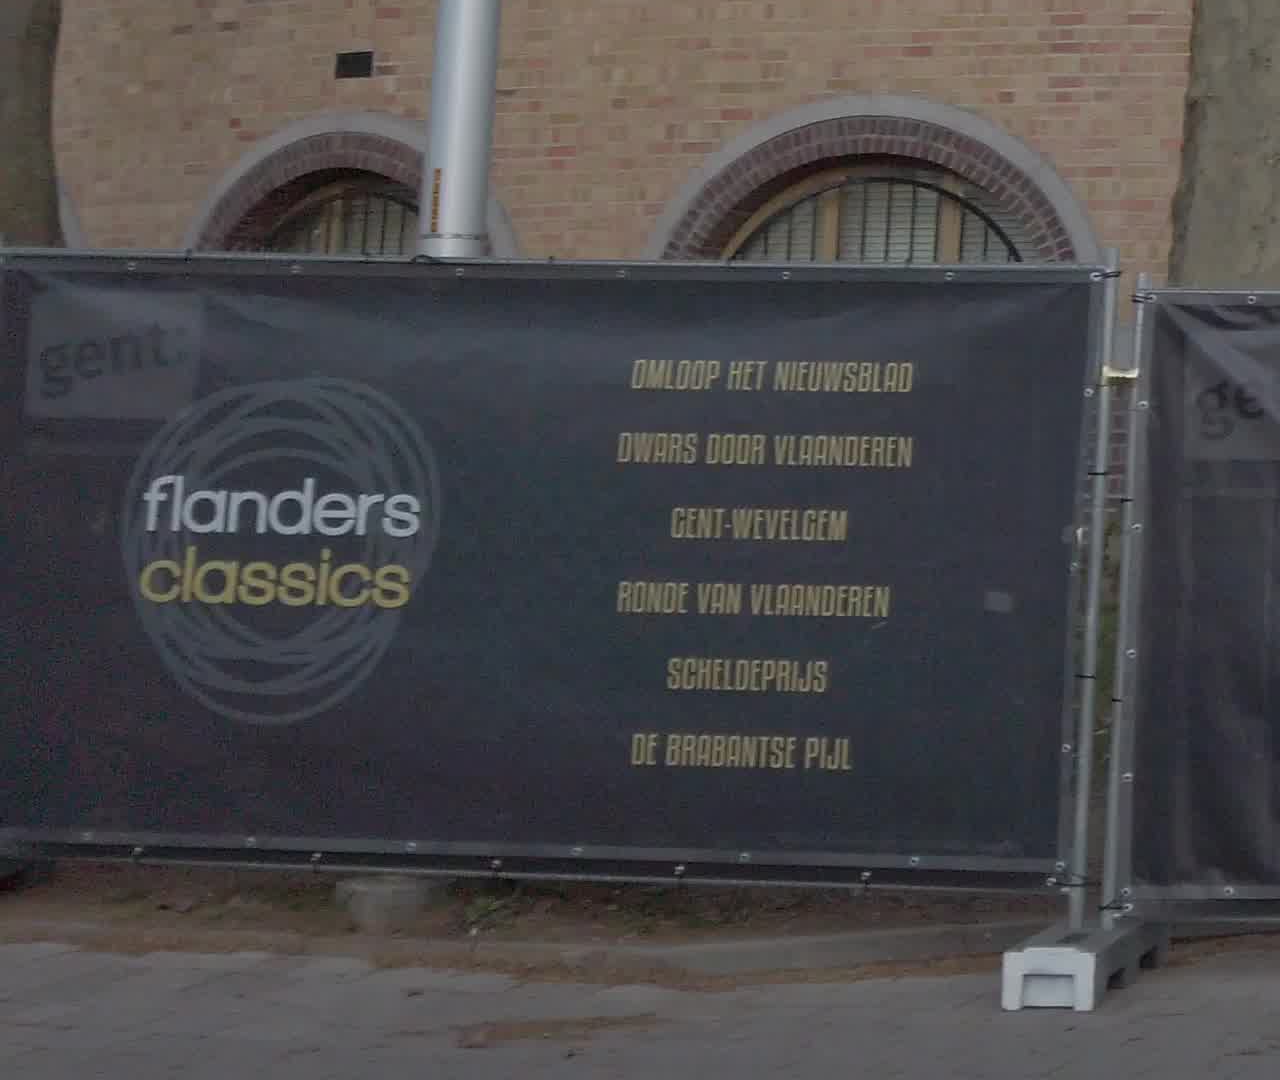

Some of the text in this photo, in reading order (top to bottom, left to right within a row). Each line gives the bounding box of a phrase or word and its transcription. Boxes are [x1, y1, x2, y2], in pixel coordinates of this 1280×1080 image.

[631, 359, 913, 393] OMLOOP HET NIEUWSBLAD
[616, 432, 913, 468] DWARS DOOR VLAANDEREN
[143, 475, 421, 537] flanders
[670, 507, 849, 541] GENT-WEVELGEM
[139, 546, 411, 609] classics
[616, 581, 890, 618] RONDE VAN VLAANDEREN
[667, 657, 829, 693] SCHELDEPRIJS
[631, 733, 852, 770] DE BRABANTSE PIJL
